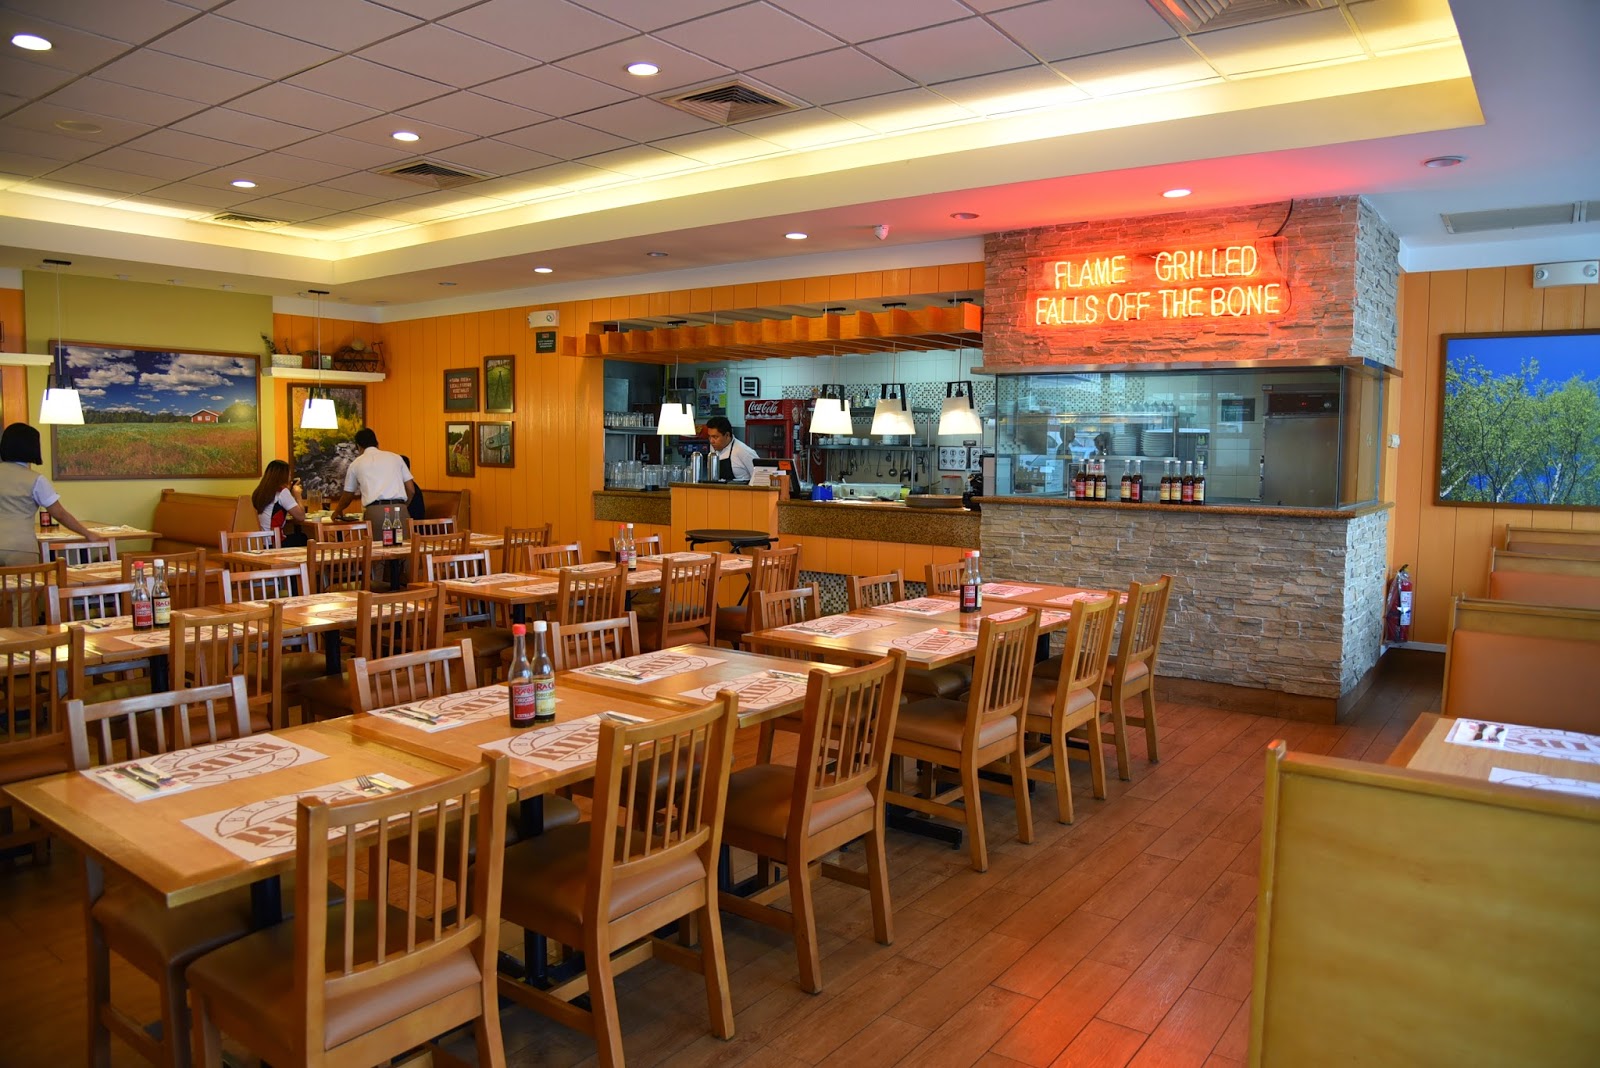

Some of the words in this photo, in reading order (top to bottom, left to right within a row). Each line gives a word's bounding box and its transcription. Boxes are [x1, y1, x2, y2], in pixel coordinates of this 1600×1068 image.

[1054, 255, 1126, 289] FLAME
[1155, 246, 1257, 281] GRILLED
[1036, 295, 1099, 325] FALLS
[1106, 292, 1150, 321] OFF
[1158, 287, 1204, 318] THE
[1210, 283, 1280, 317] BONE
[171, 742, 288, 781] RIBS
